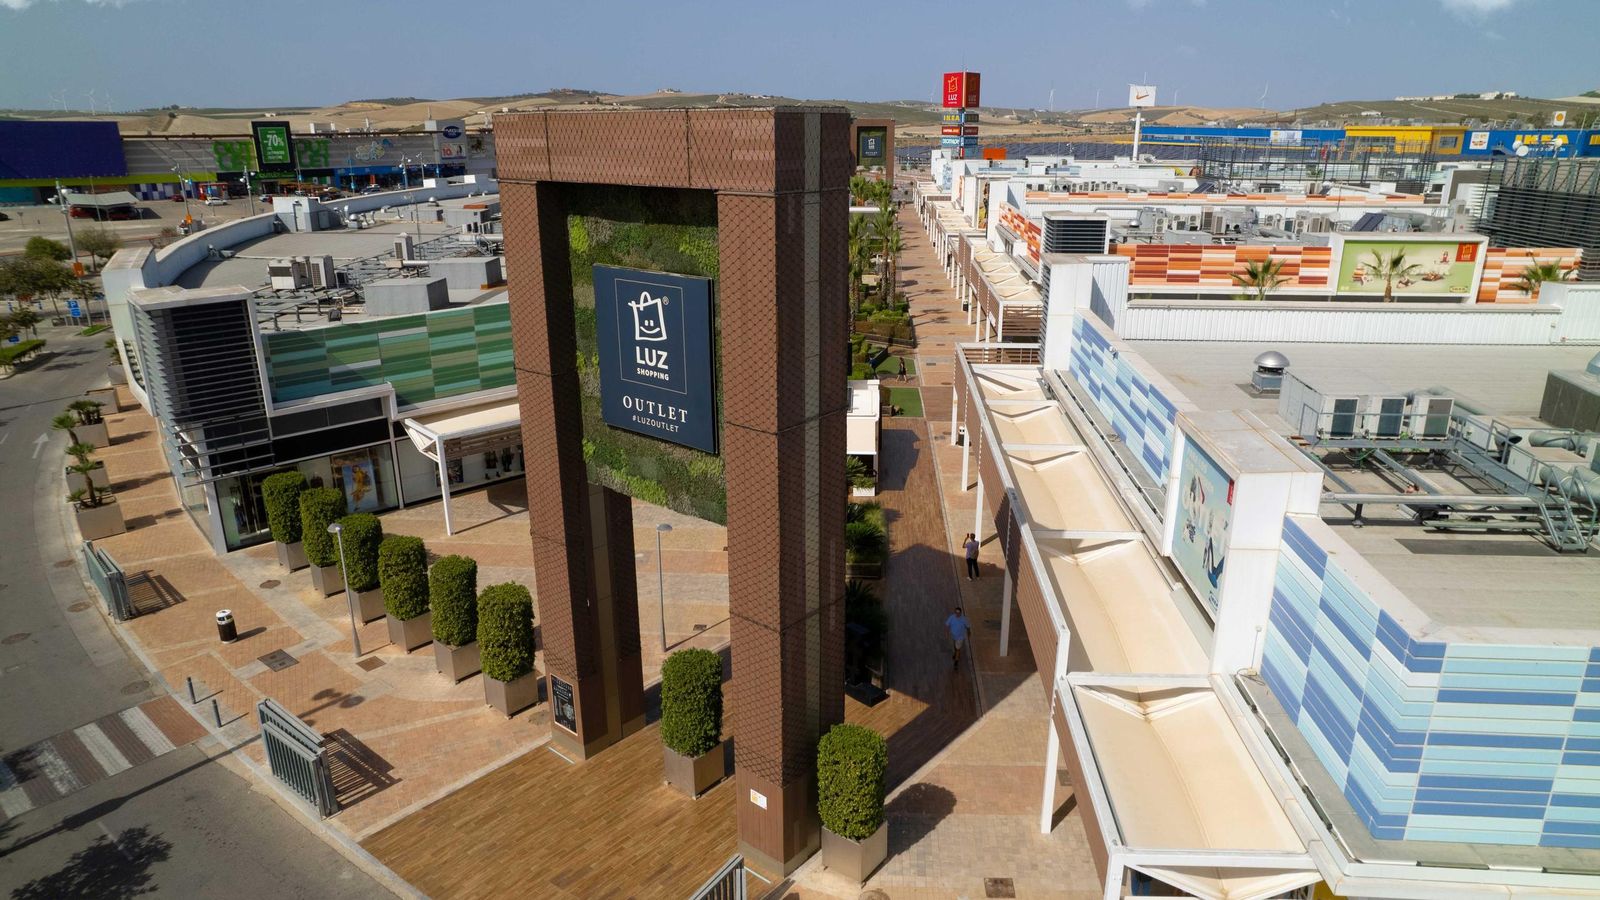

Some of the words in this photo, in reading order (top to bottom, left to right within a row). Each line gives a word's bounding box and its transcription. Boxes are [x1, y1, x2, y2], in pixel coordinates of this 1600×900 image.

[264, 135, 284, 147] -70%
[1515, 134, 1569, 145] IKEA
[635, 345, 669, 370] LUZ
[636, 367, 670, 381] SHOPPING
[622, 395, 688, 423] OUTLET
[632, 415, 679, 433] #LUZOUTLET
